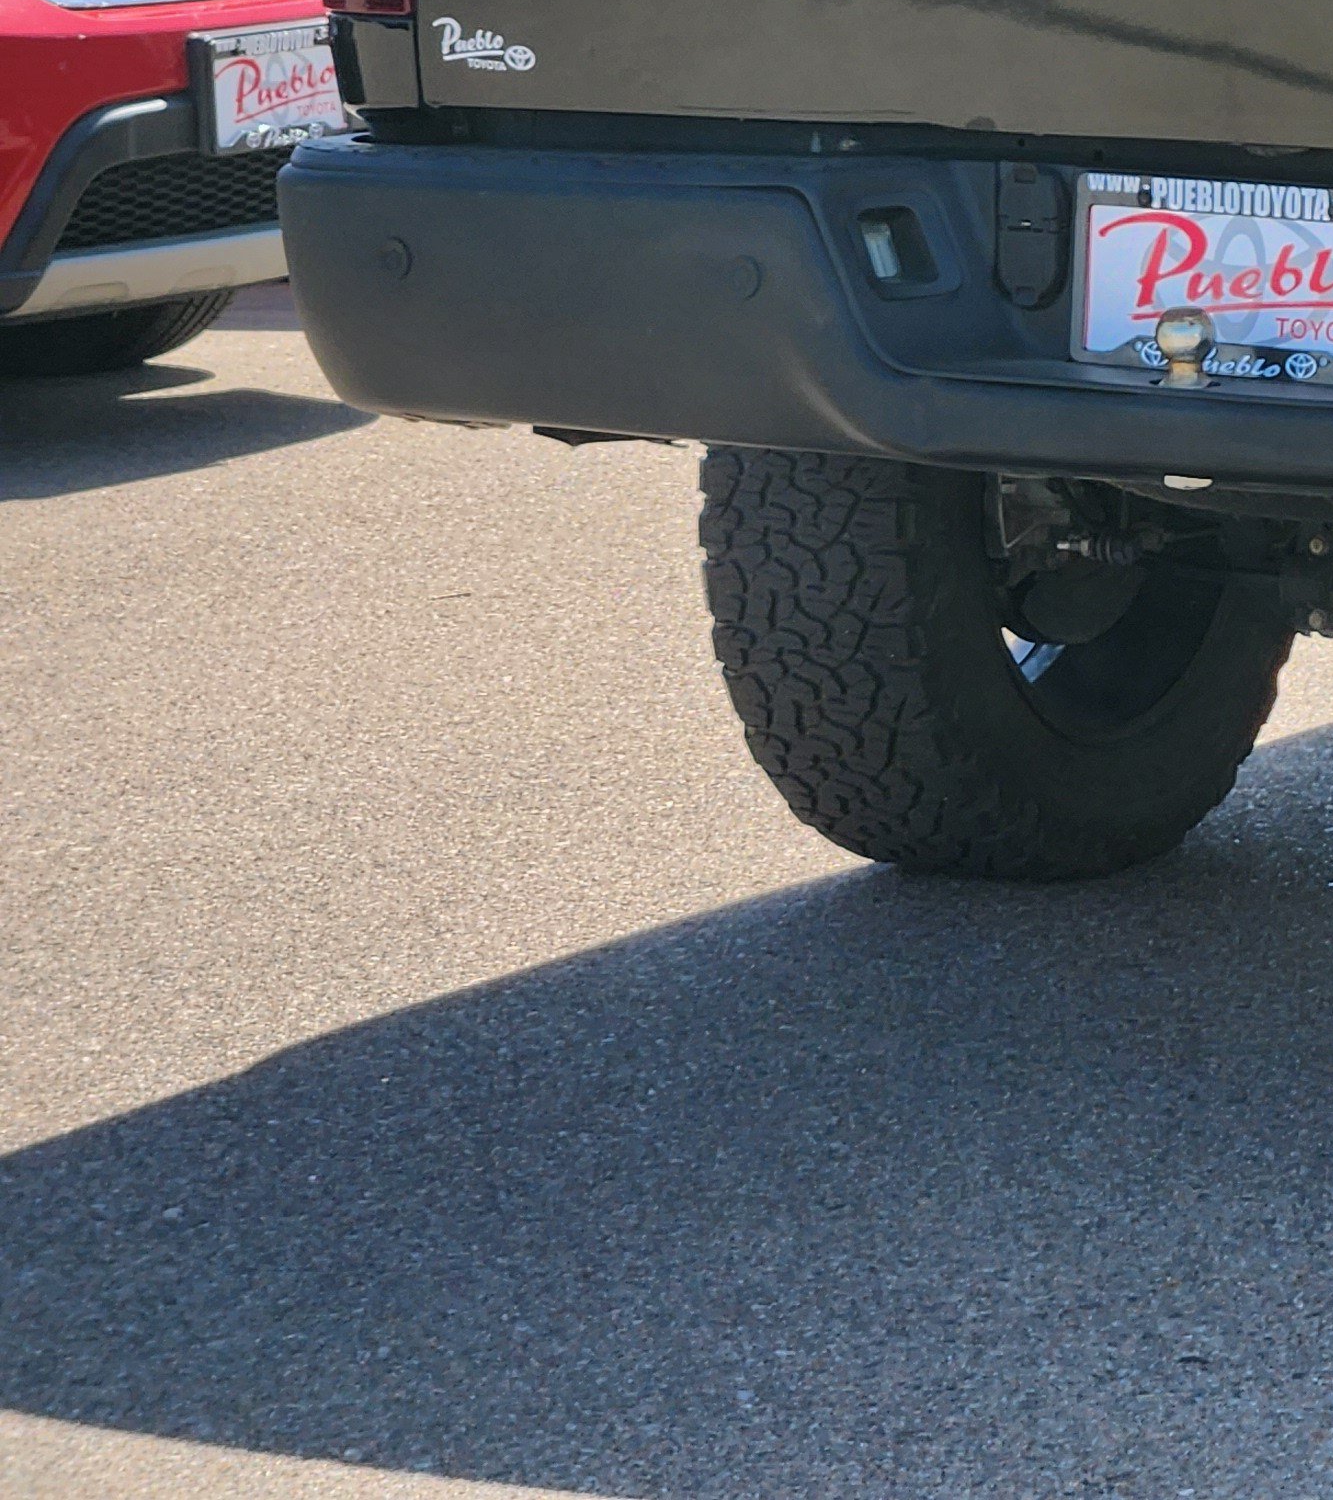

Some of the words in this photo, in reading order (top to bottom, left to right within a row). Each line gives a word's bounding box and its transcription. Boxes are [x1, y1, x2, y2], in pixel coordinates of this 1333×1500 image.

[432, 16, 504, 55] Pueblo
[466, 57, 507, 71] TOYOTA
[214, 57, 335, 115] Pueblo
[1202, 348, 1281, 378] ueblo
